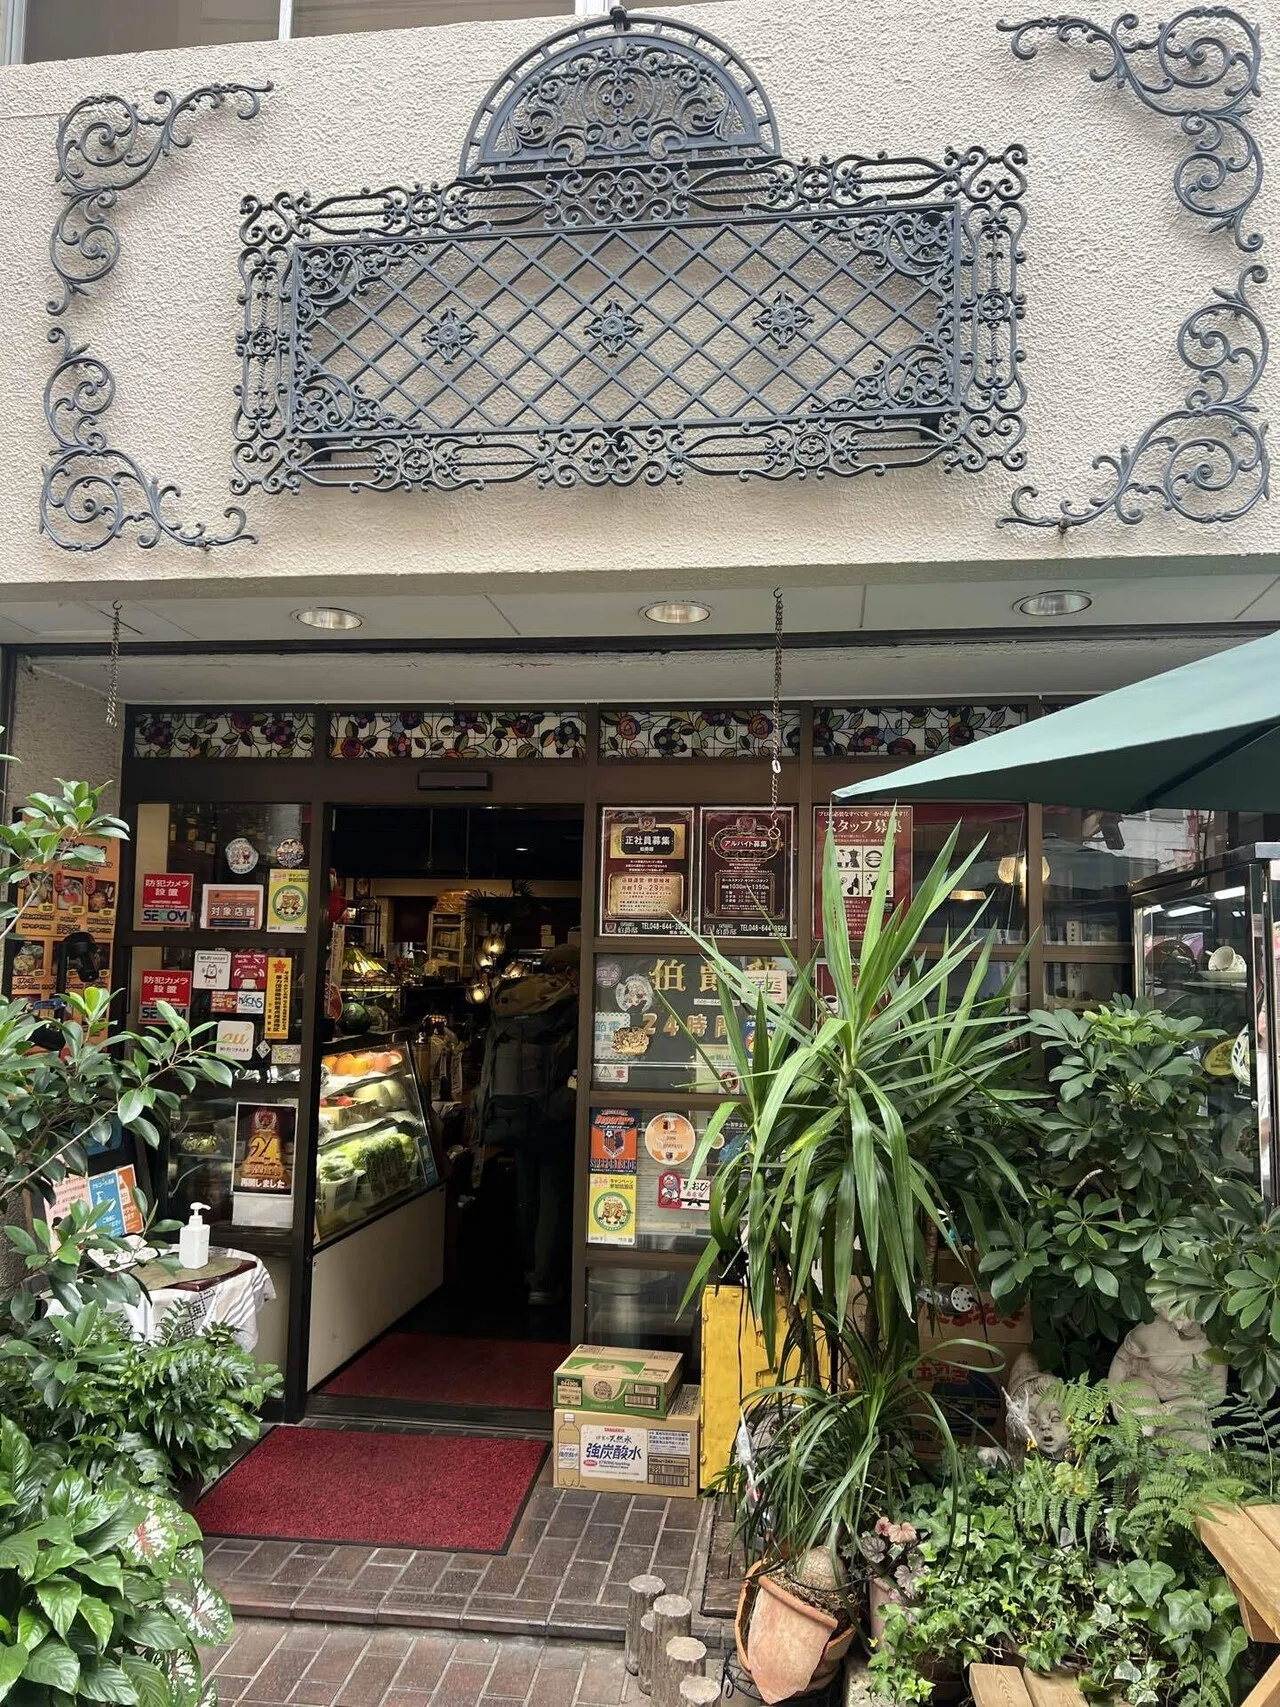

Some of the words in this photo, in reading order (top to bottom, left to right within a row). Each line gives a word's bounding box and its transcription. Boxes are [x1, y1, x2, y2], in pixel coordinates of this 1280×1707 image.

[625, 836, 670, 845] 正社員募集
[145, 879, 190, 888] 防犯カメラ
[155, 888, 179, 897] 設置
[143, 909, 188, 922] SECOM
[211, 906, 255, 917] 対象店舗
[143, 975, 189, 984] 防犯カメラ
[142, 1007, 186, 1019] SEM
[586, 1443, 642, 1460] 強炭酸水
